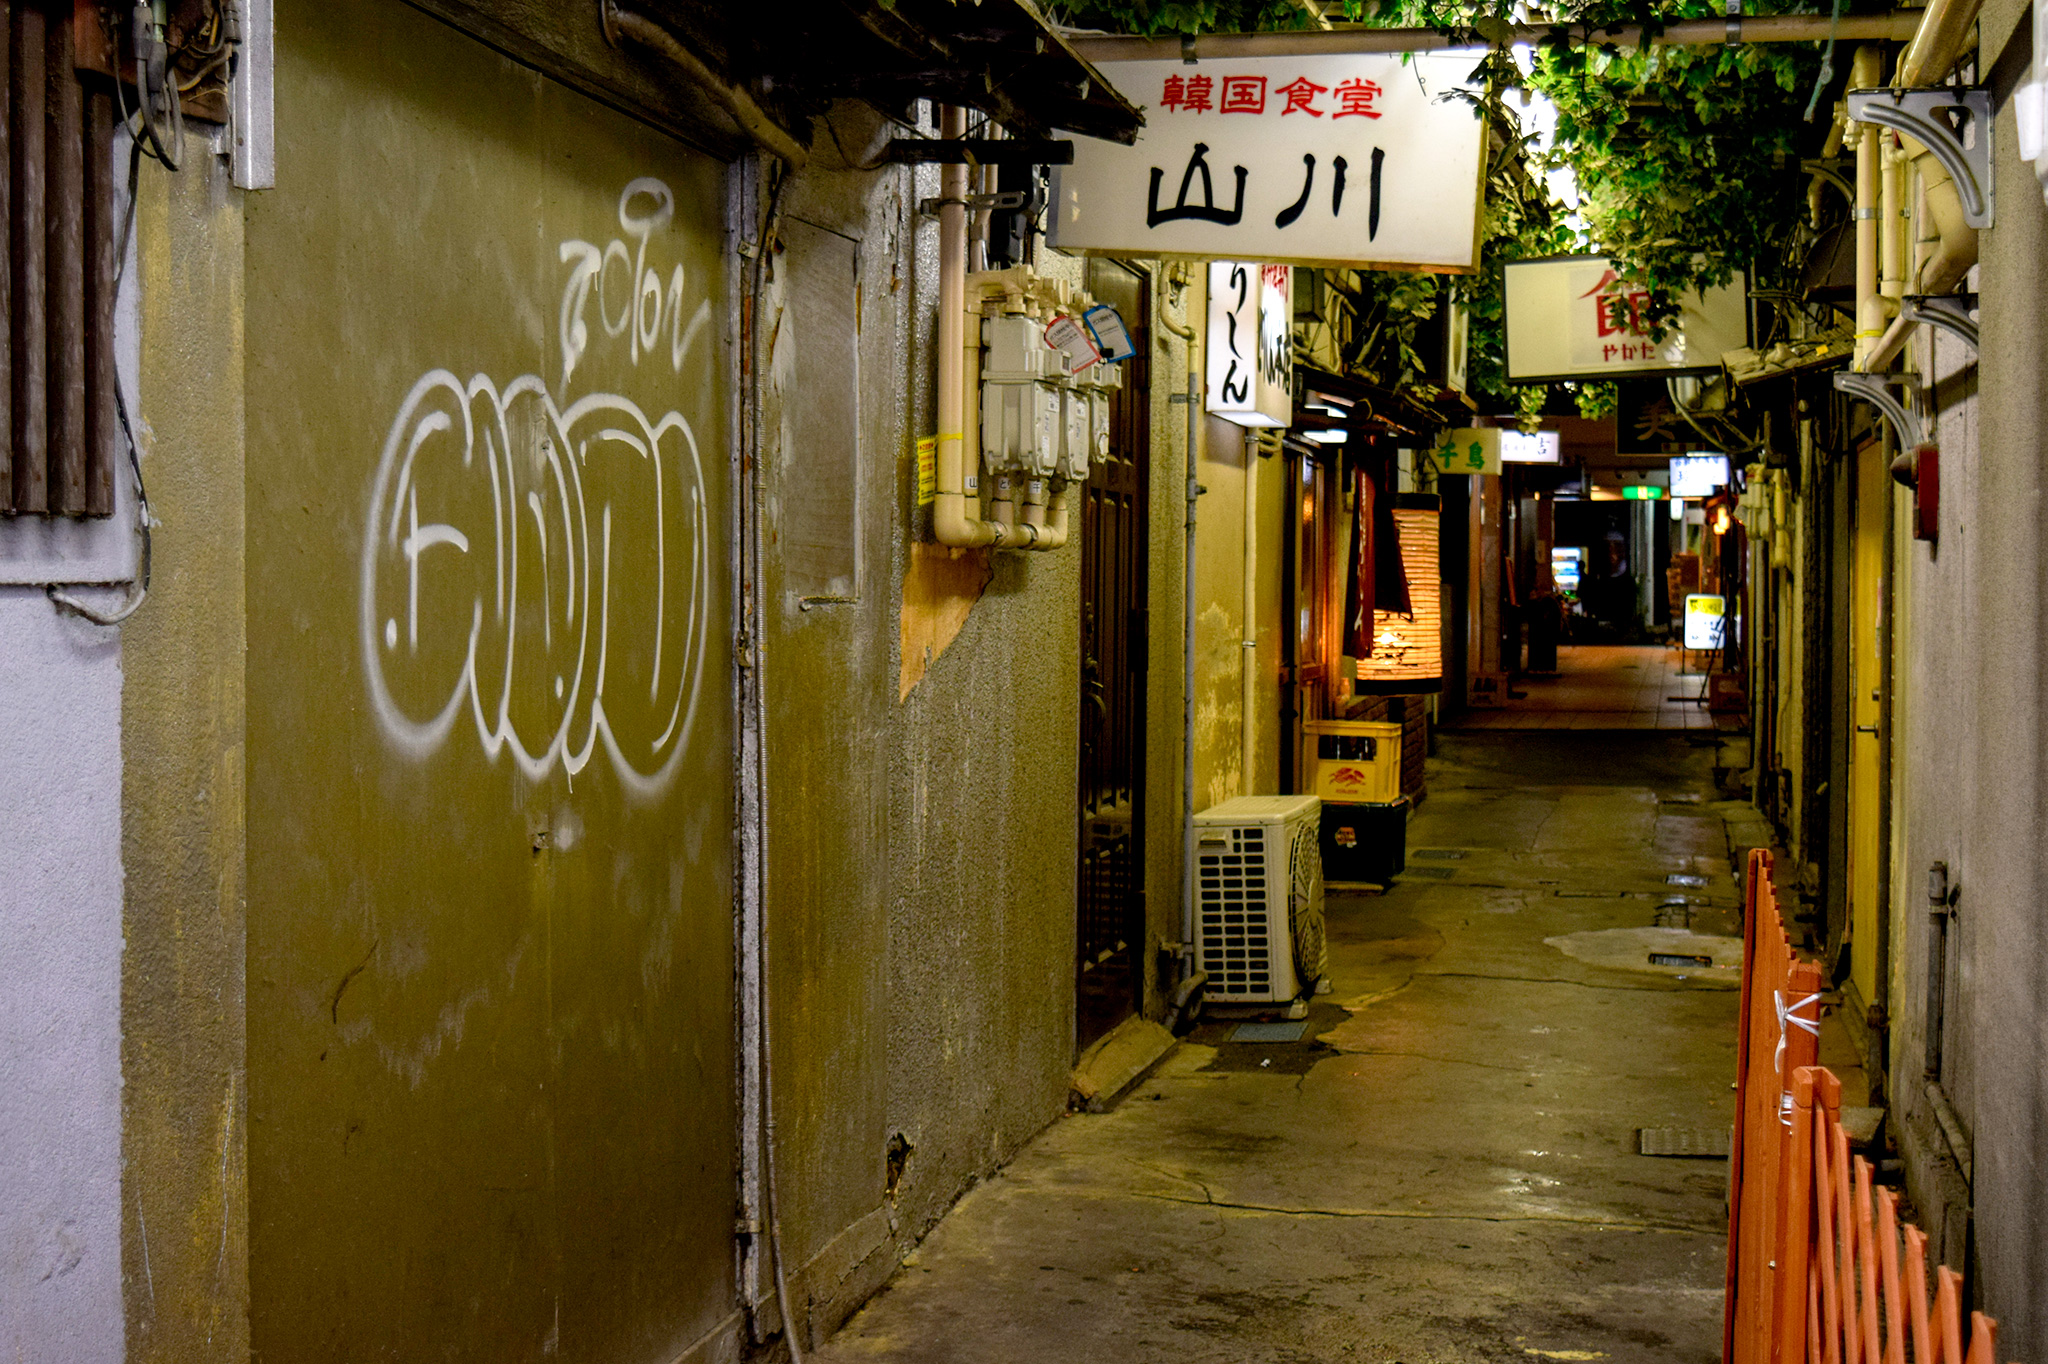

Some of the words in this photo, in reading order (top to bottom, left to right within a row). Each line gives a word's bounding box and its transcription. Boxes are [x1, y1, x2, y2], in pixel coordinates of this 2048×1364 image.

[1160, 74, 1383, 120] 韓国食堂
[1146, 142, 1386, 242] 山川
[1602, 342, 1656, 361] やかた
[1437, 441, 1485, 470] 千鳥
